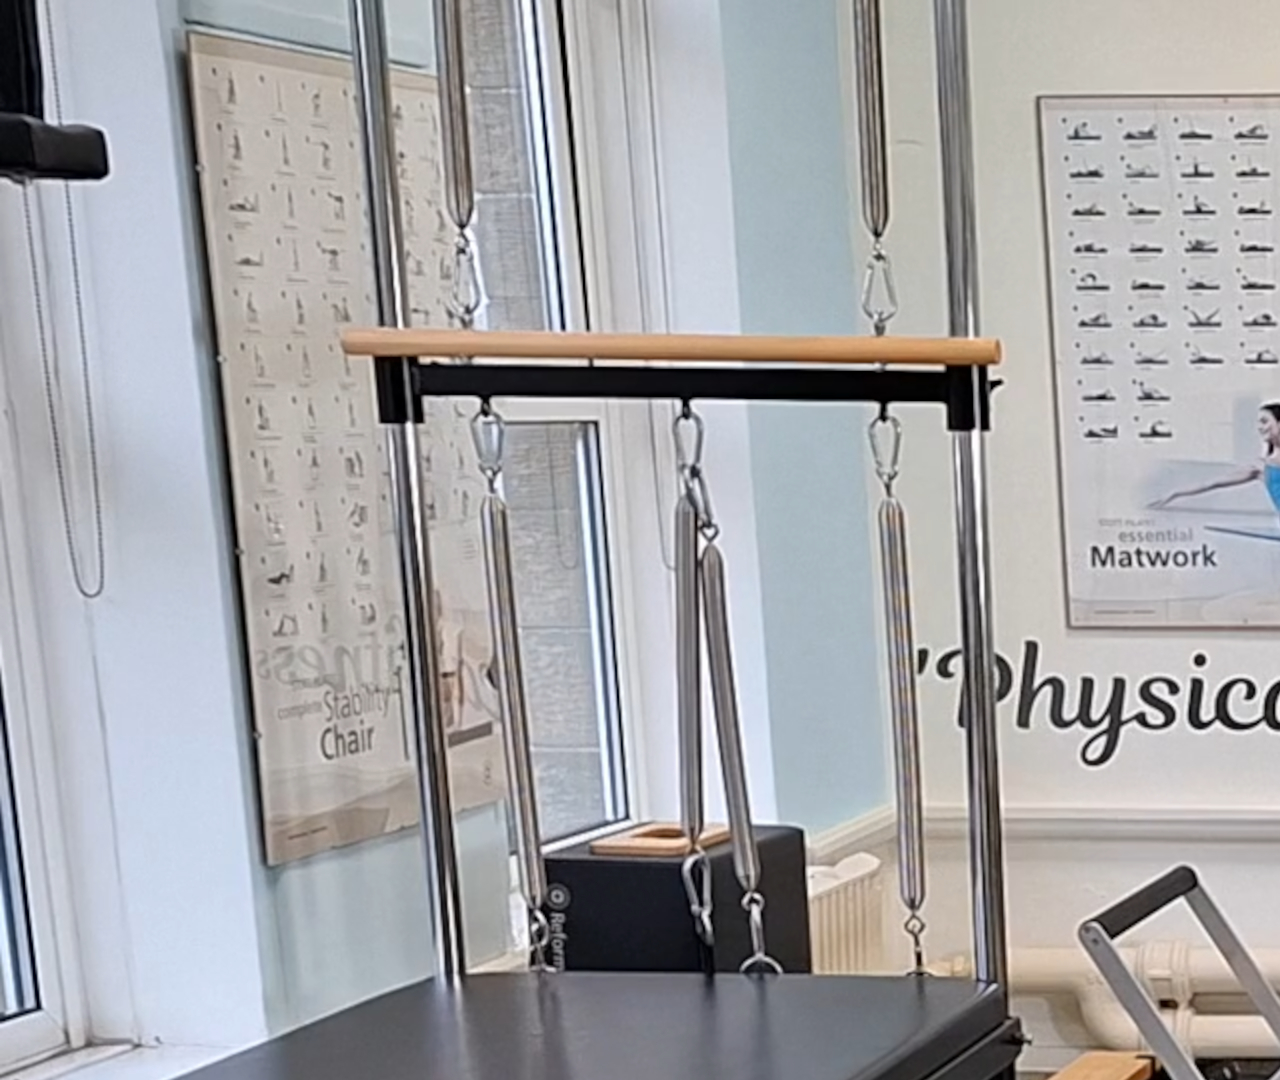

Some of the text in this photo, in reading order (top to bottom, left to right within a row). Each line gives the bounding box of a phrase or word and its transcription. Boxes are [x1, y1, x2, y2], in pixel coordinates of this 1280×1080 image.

[1118, 528, 1193, 542] essential
[1090, 544, 1218, 568] Matwork
[322, 683, 390, 723] Stability
[320, 719, 375, 760] Chair
